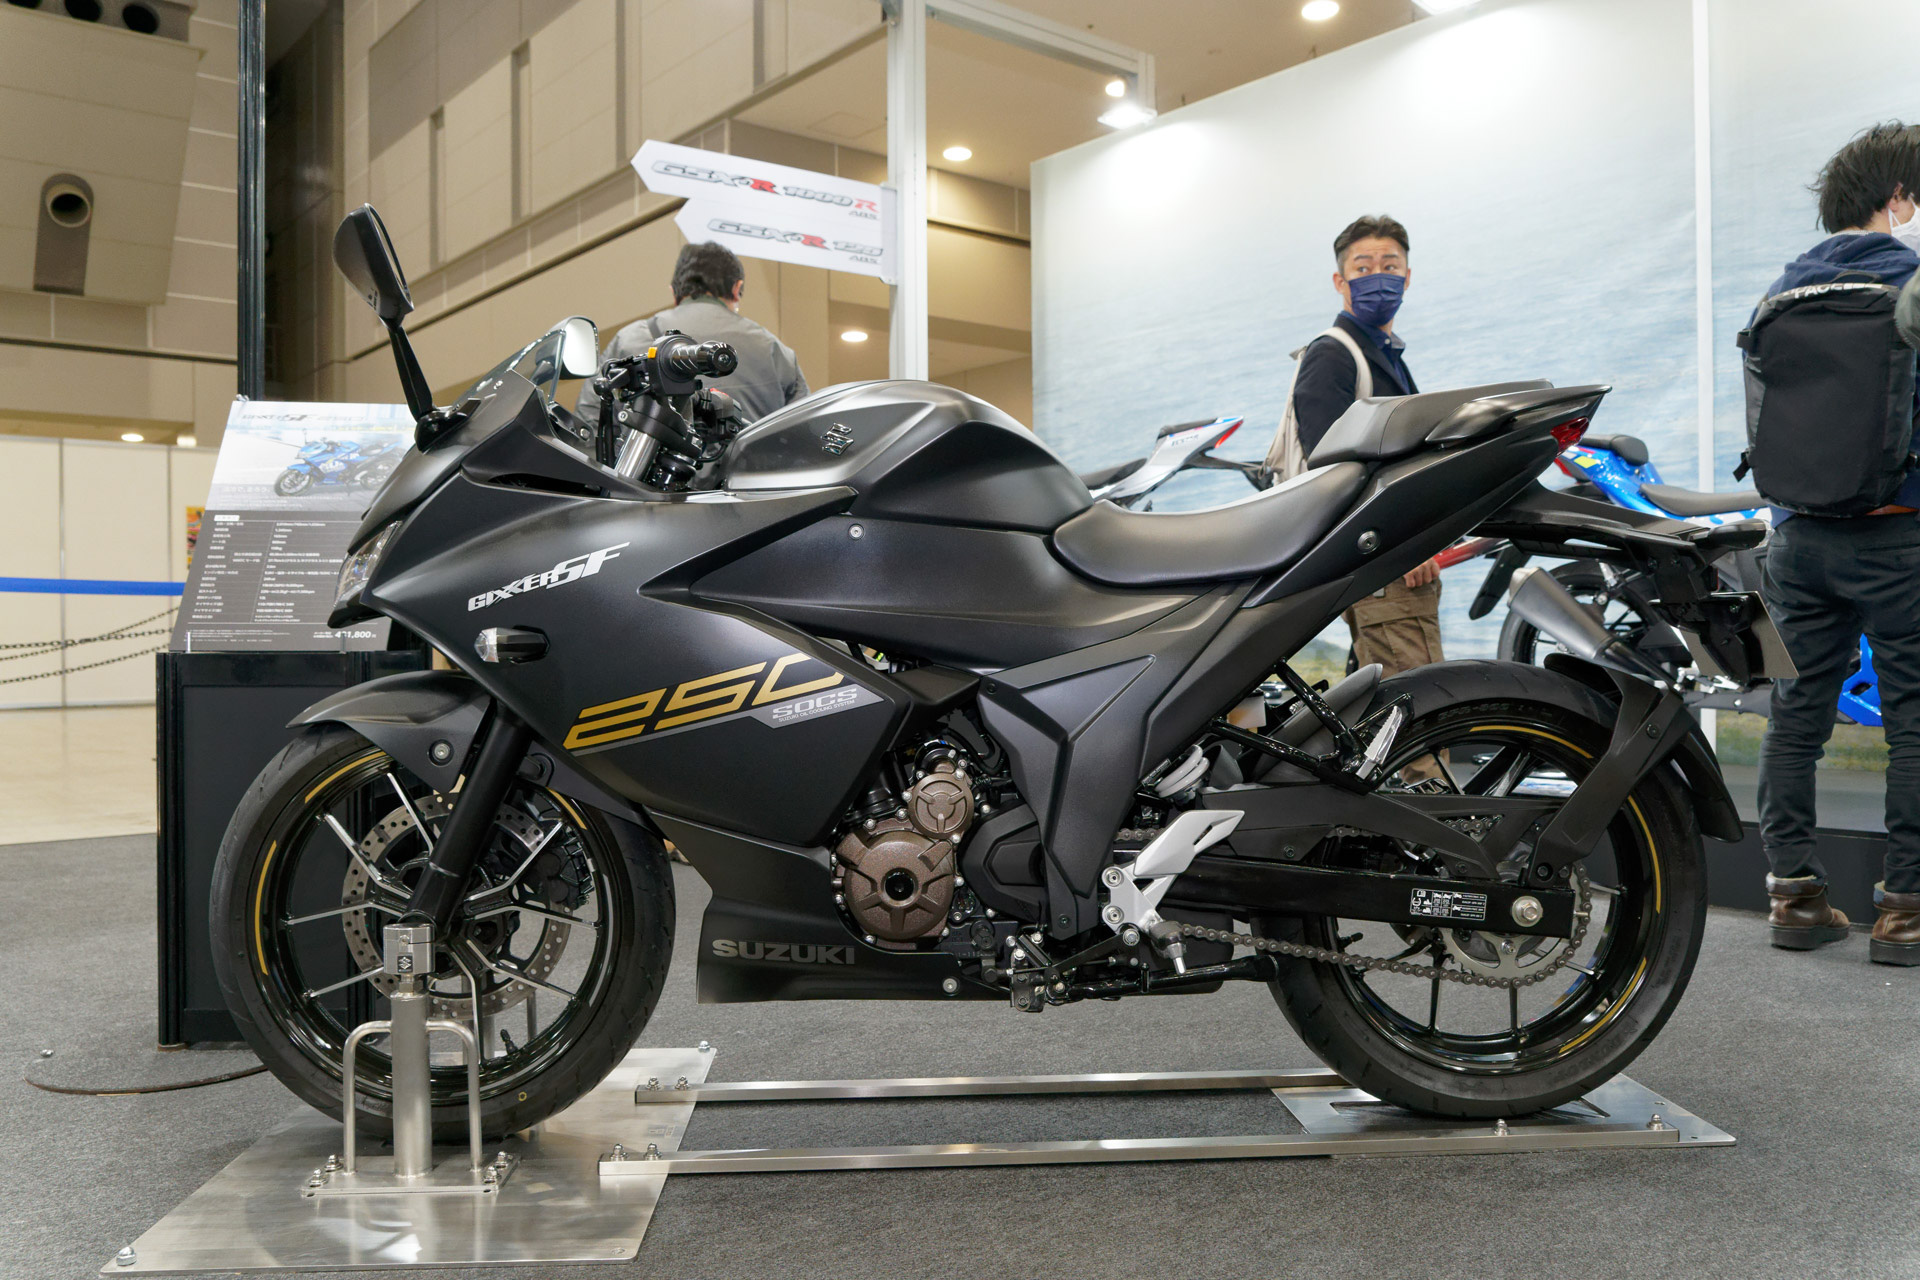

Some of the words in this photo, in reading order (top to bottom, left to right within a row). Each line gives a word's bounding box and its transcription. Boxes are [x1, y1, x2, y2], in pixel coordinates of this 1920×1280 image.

[562, 652, 845, 750] 250
[772, 688, 858, 719] SOCS
[779, 713, 799, 722] SUZUKI
[809, 705, 832, 714] COOLING
[833, 699, 855, 708] SYSTEM
[711, 939, 855, 965] SUZUKI
